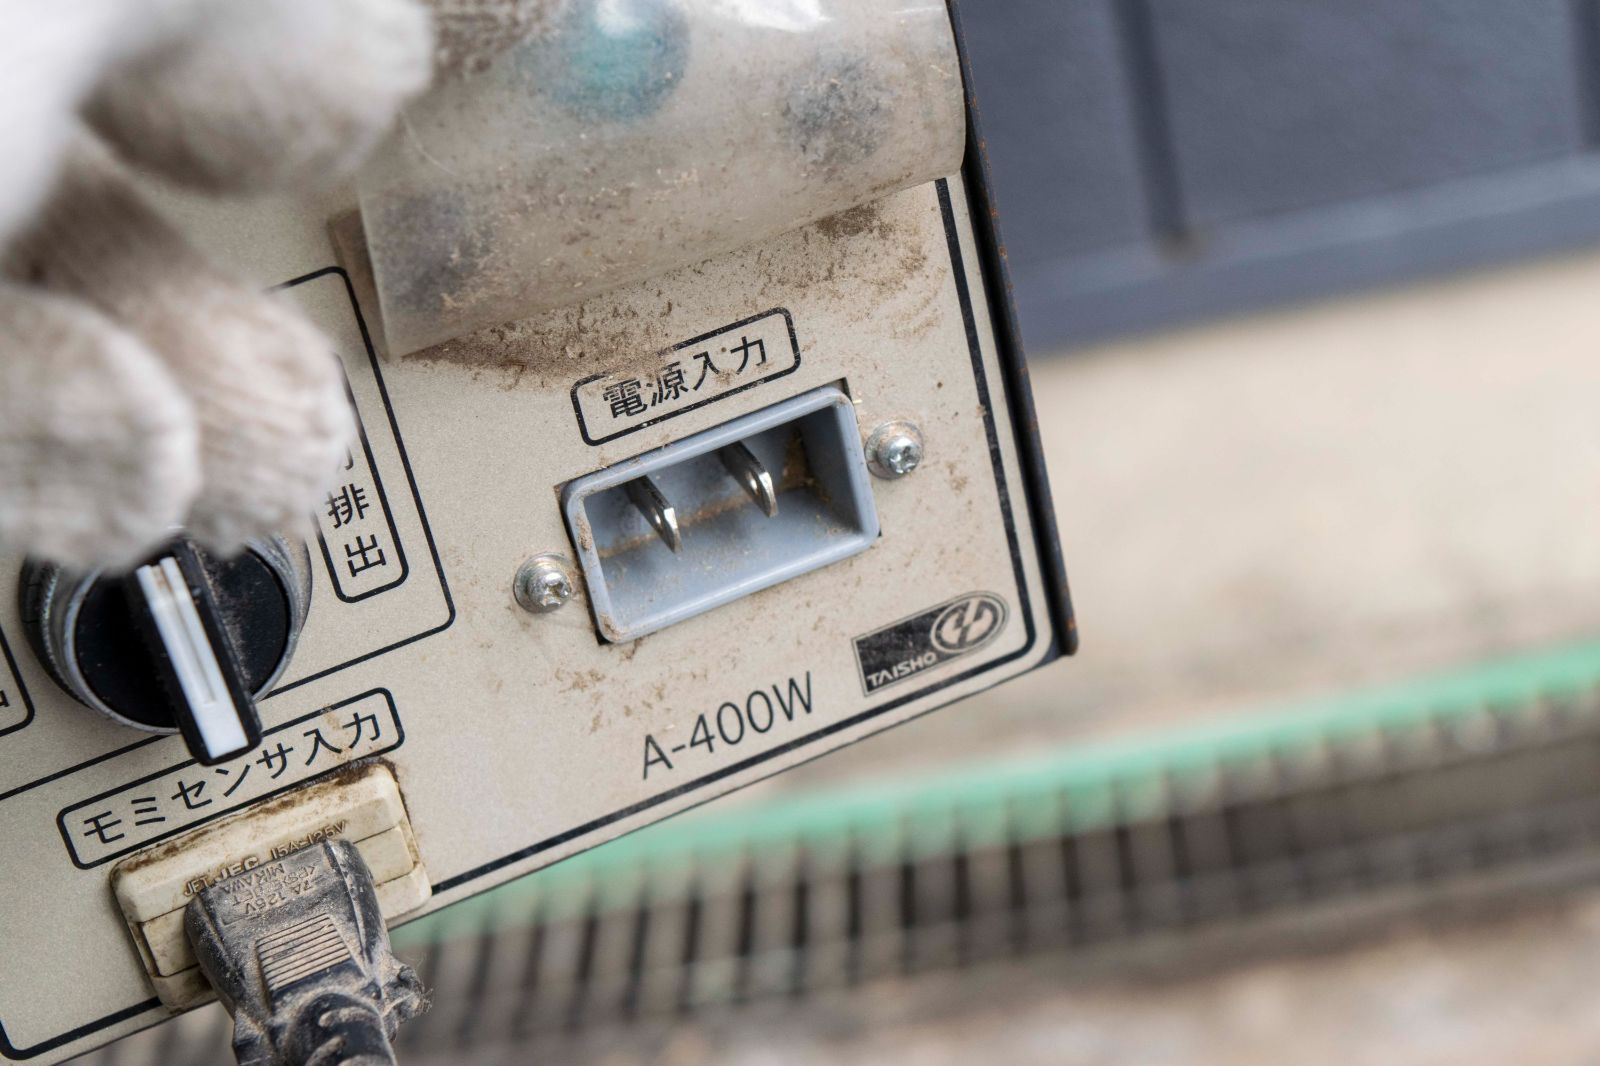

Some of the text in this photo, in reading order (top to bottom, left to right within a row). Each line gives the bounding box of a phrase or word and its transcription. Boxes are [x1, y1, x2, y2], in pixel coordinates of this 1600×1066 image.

[602, 336, 767, 419] 電源入力
[867, 652, 937, 687] TAISHO
[643, 671, 813, 780] A-400W
[83, 712, 382, 844] モミセンサ入力
